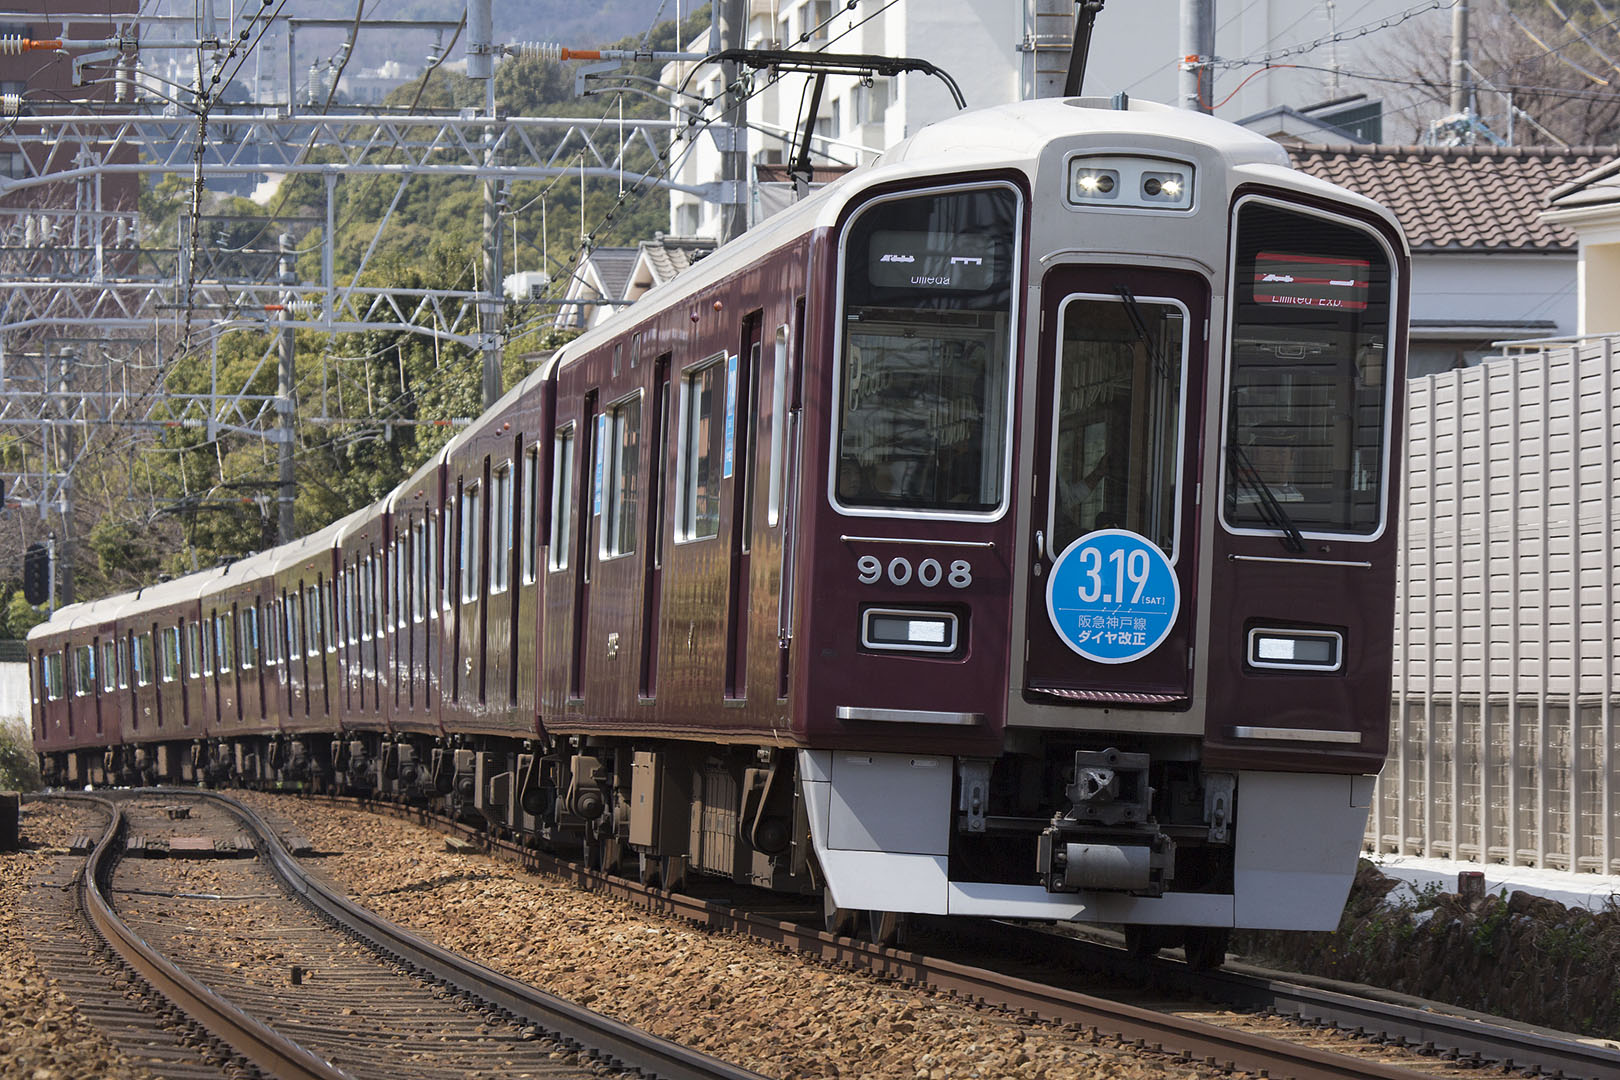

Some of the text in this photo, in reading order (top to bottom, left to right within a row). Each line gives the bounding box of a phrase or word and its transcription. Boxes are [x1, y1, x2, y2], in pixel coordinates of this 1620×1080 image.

[857, 555, 972, 589] 9008
[1077, 546, 1151, 604] 3.19
[1078, 614, 1147, 631] 阪急神戸線
[1078, 630, 1147, 646] ダイヤ改正
